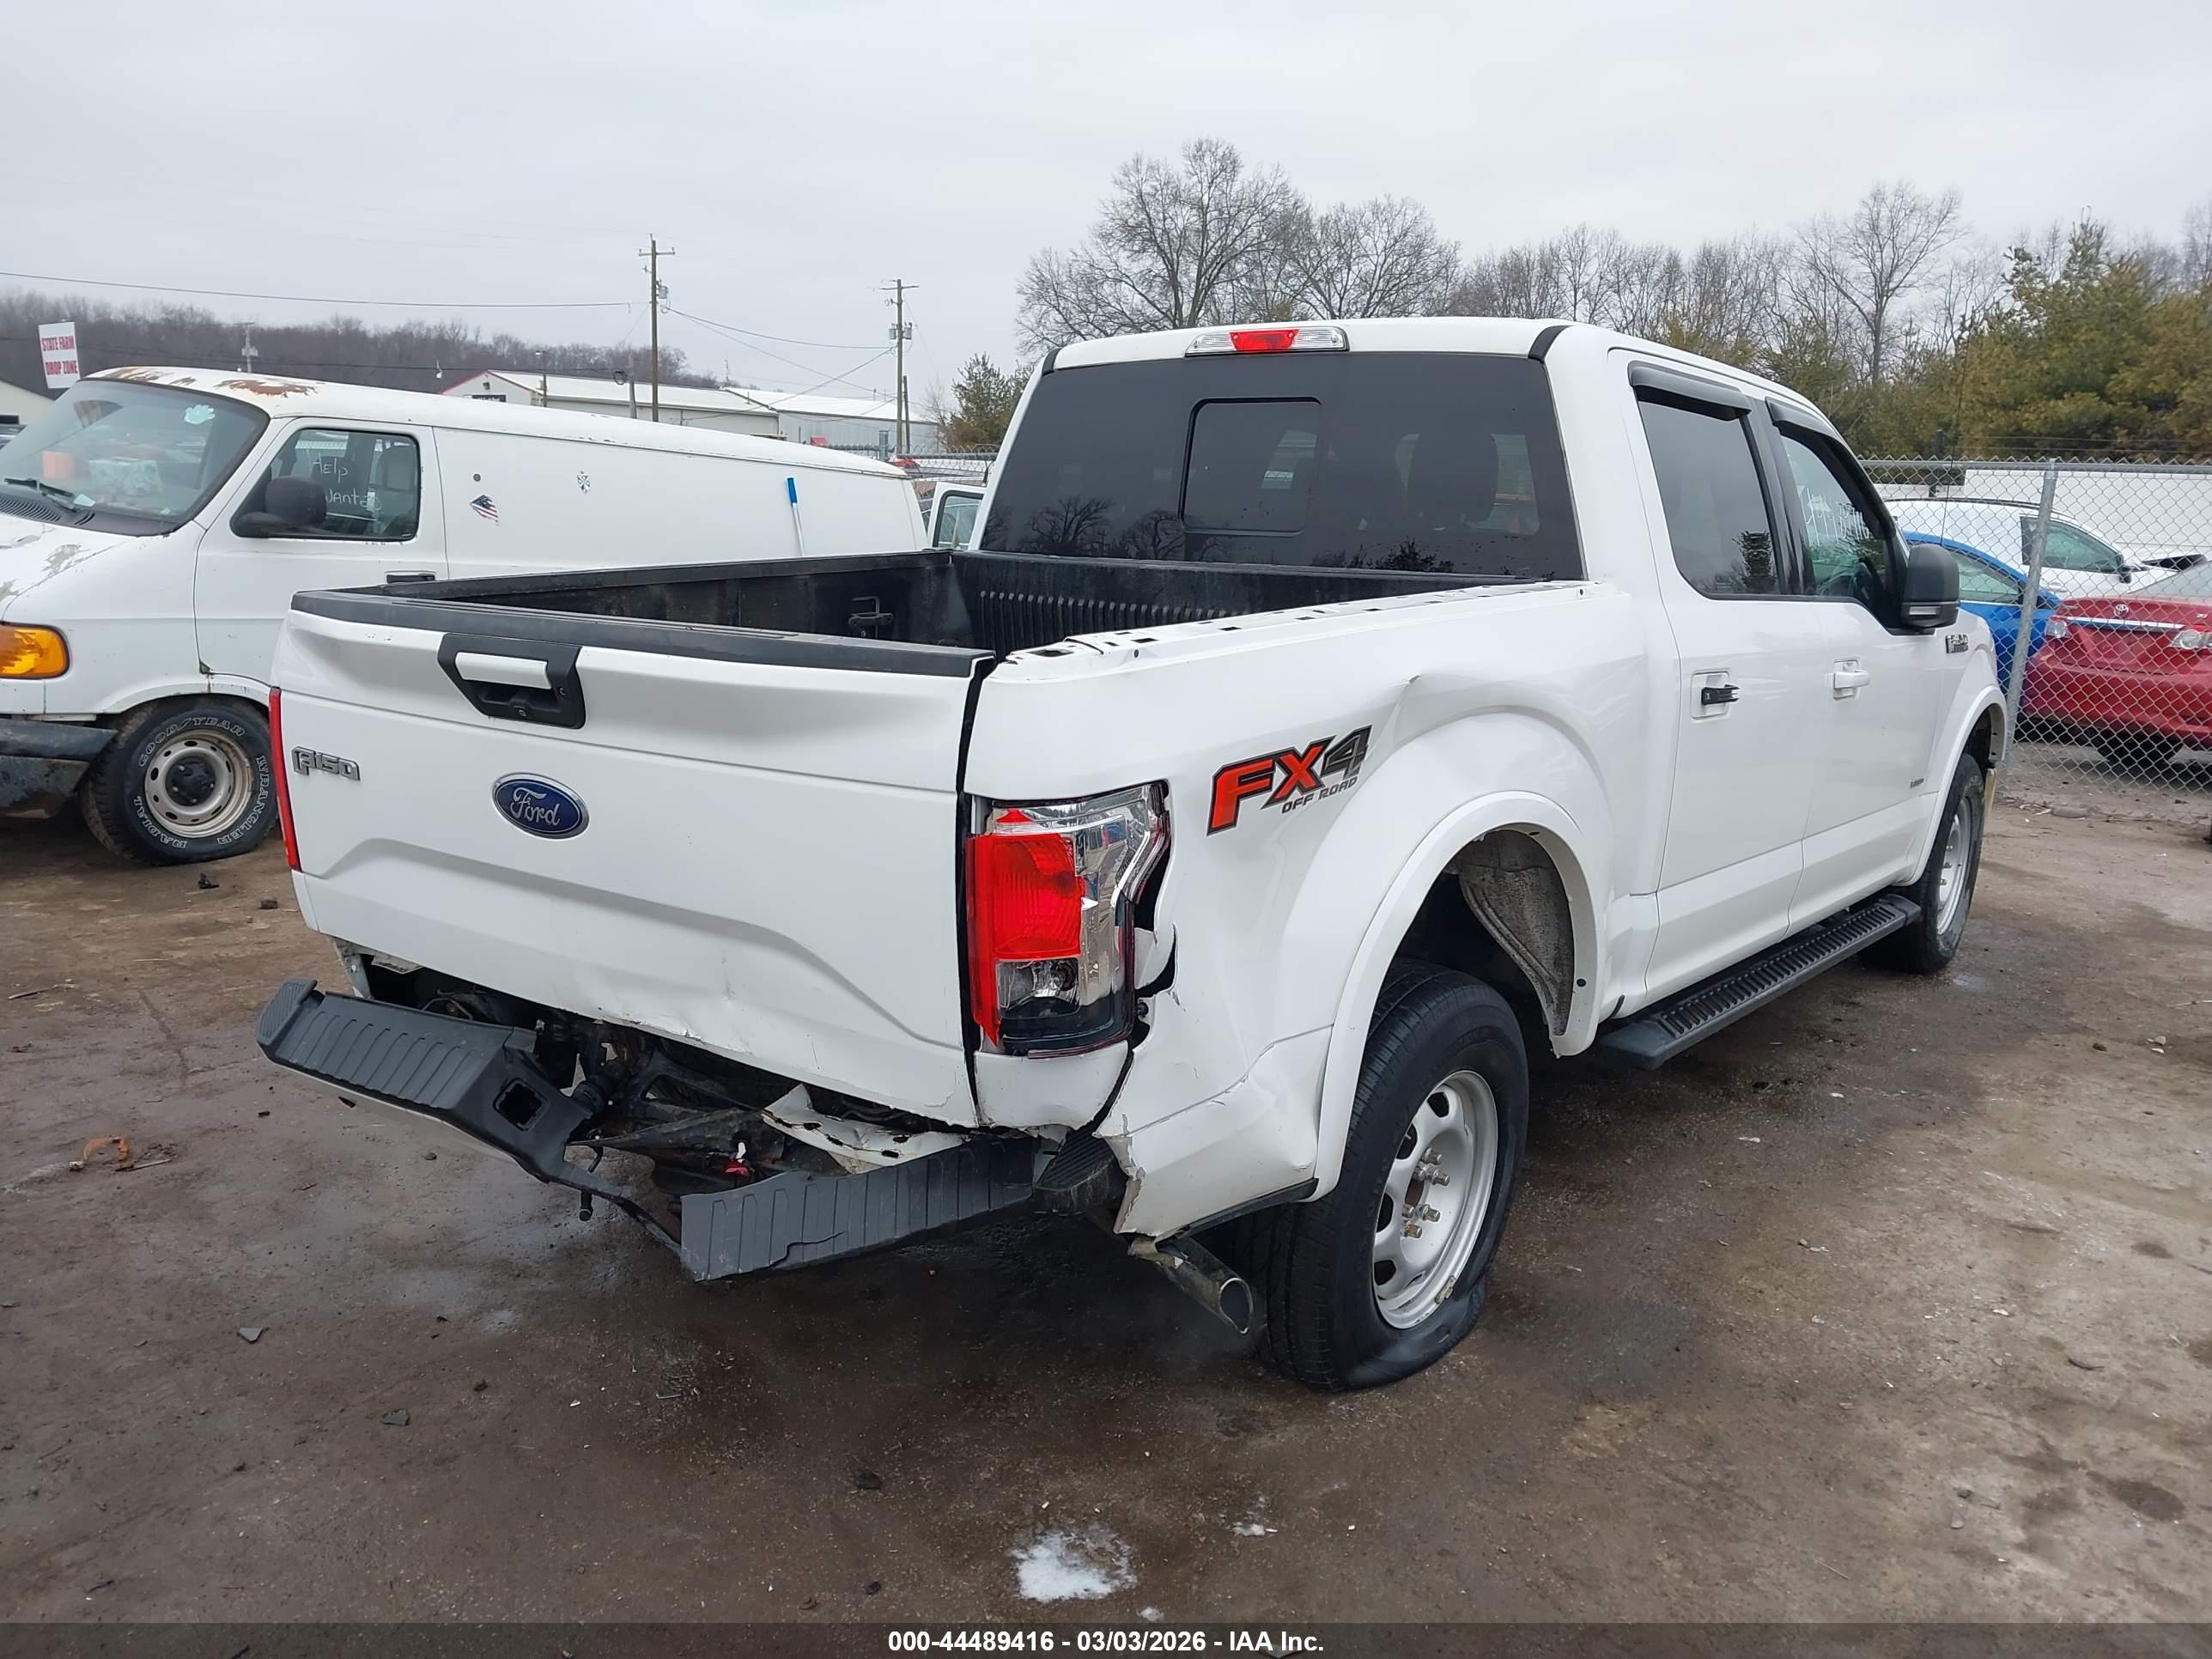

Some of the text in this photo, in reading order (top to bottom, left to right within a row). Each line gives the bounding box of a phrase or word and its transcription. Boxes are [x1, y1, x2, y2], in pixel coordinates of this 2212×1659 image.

[41, 336, 75, 351] STATE FARM
[45, 360, 78, 375] DROP ZONE
[1206, 724, 1373, 837] FX4
[1281, 776, 1358, 815] OFF ROAD
[133, 755, 270, 848] WRANGLER RADIAL
[509, 786, 562, 828] Ford
